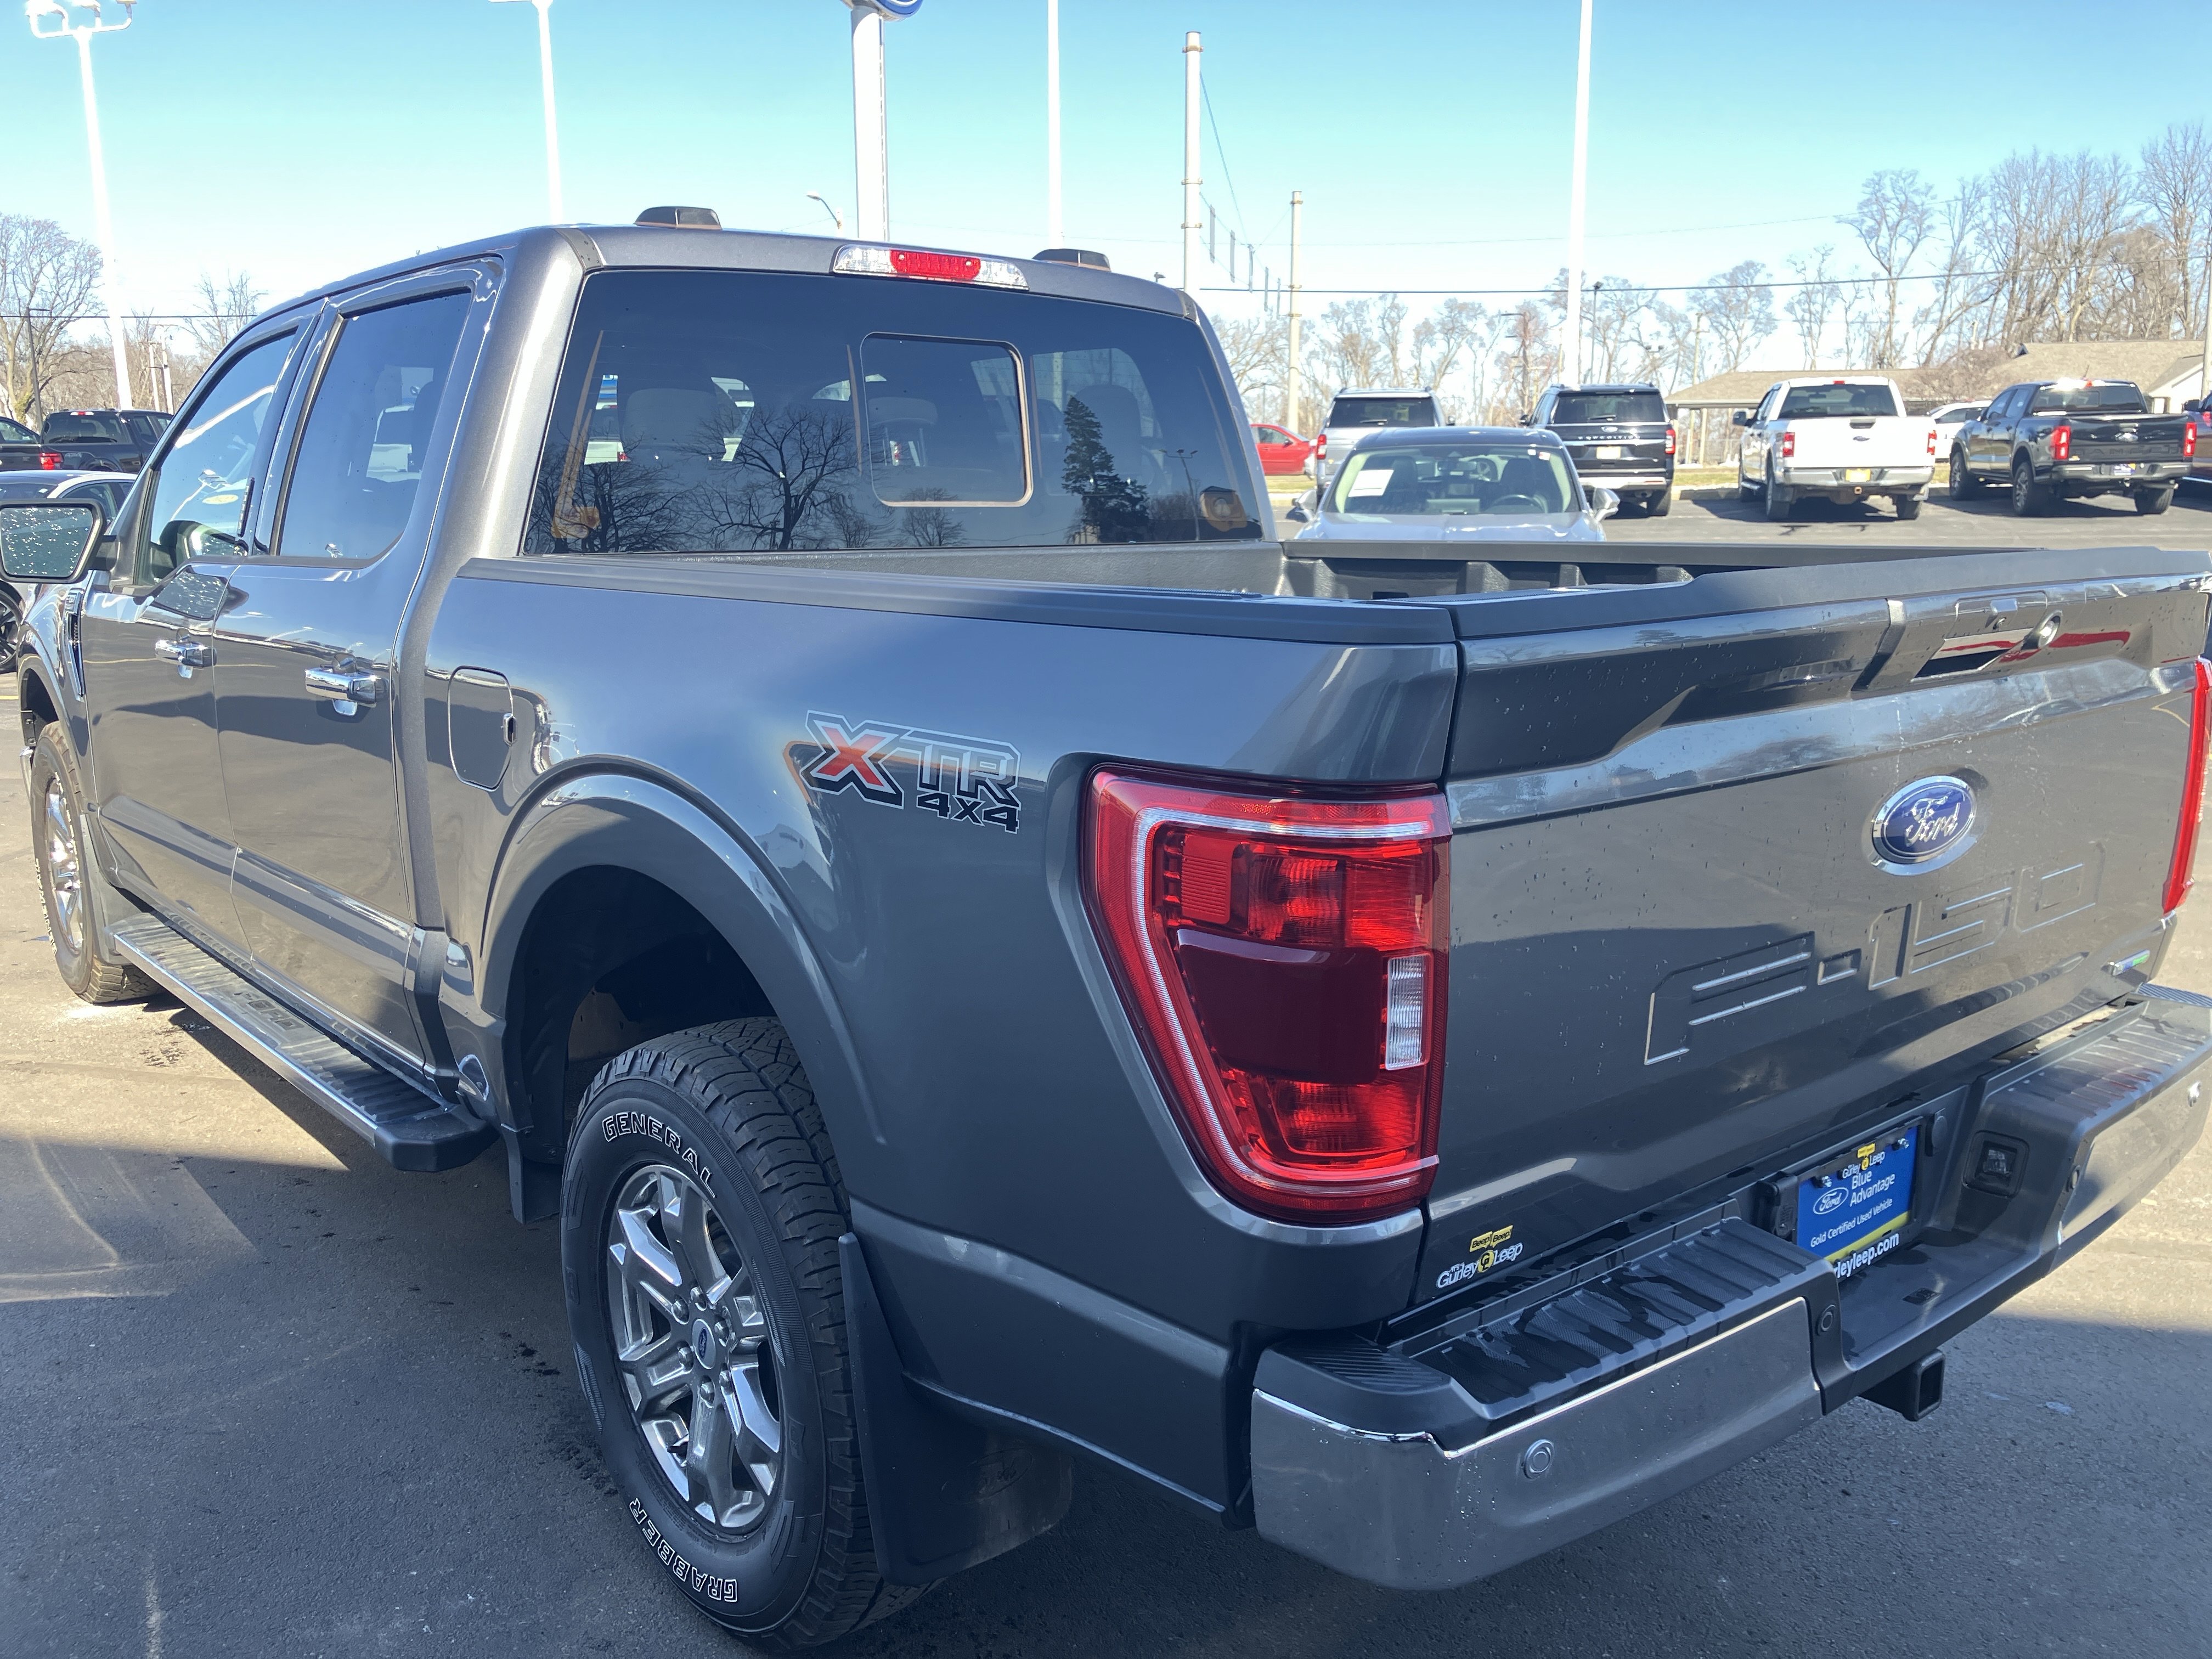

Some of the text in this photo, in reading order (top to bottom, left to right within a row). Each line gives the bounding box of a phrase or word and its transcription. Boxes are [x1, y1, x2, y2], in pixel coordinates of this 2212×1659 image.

[1902, 795, 1961, 847] Ford
[1645, 843, 2106, 1065] F-150
[602, 1111, 715, 1198] GENERAL
[1819, 1191, 1843, 1212] Ford
[1849, 1173, 1895, 1207] Advantage
[1852, 1171, 1872, 1189] Blue
[1810, 1198, 1893, 1248] Gold Certified Used Vehicle
[1437, 1260, 1480, 1288] Gurley
[1493, 1242, 1523, 1266] Leep
[1833, 1233, 1899, 1279] rleyleep.com
[629, 1497, 737, 1602] GRABBER
